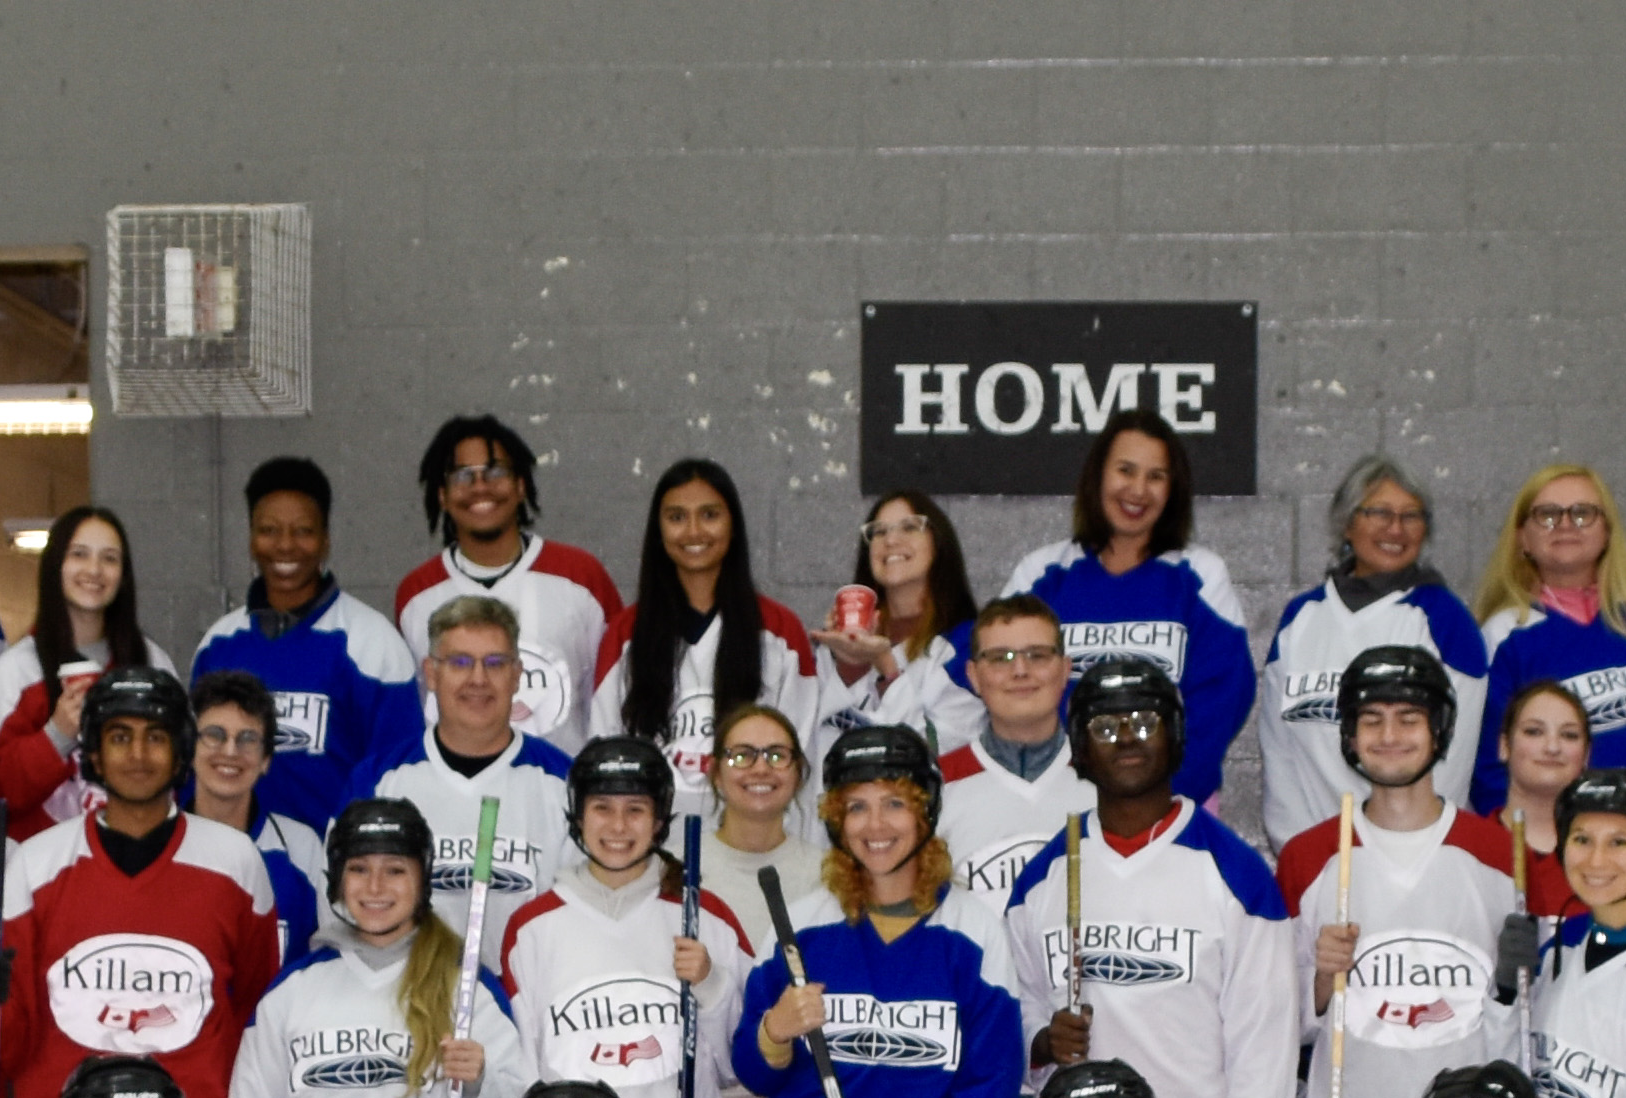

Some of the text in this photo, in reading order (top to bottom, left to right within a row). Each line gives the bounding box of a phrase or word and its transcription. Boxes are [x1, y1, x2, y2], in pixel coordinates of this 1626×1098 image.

[894, 362, 1217, 435] HOME
[1062, 622, 1188, 682] LBRIGHT
[64, 955, 193, 994] Killam
[1044, 924, 1202, 989] FUBRIGHT
[549, 995, 679, 1036] Killam
[825, 997, 959, 1065] ULBRIGHT
[289, 1027, 415, 1092] FULBRIG
